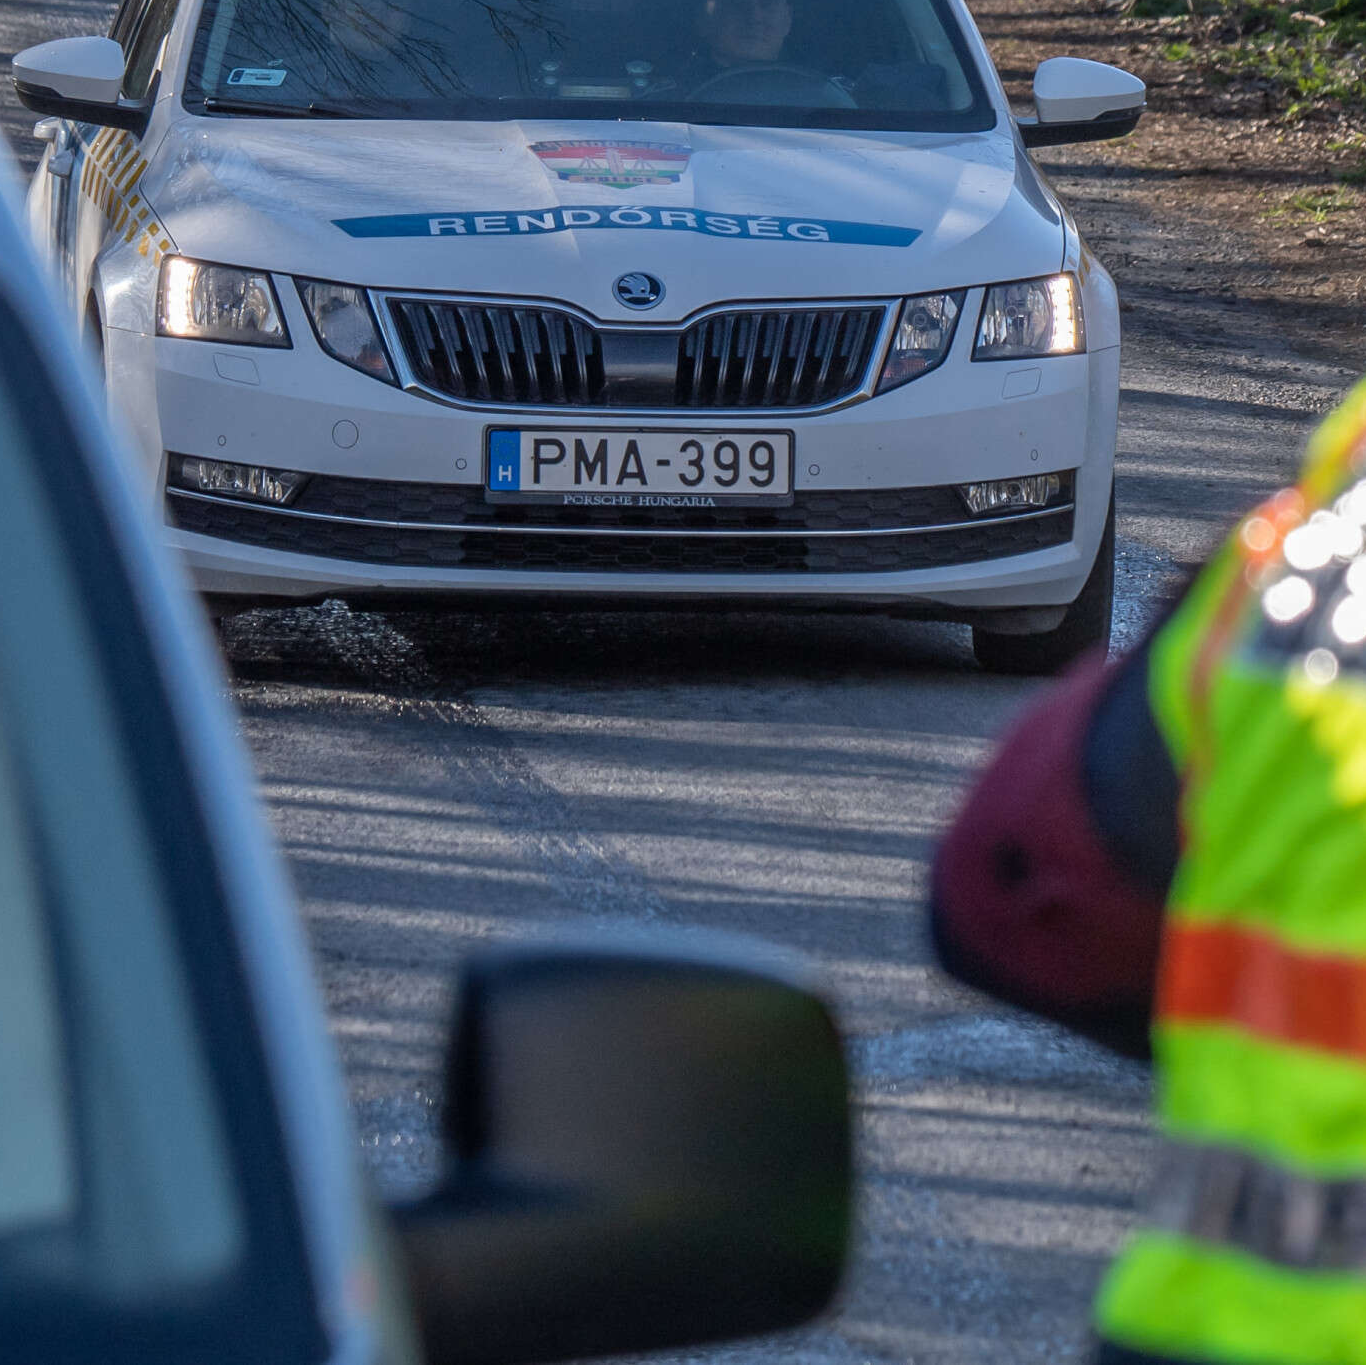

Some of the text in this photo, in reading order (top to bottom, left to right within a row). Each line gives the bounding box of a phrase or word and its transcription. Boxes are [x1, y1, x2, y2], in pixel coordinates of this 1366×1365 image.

[428, 206, 830, 242] RENDŐRSÉG
[498, 464, 512, 483] H
[532, 437, 775, 488] PMA-399
[563, 493, 716, 508] PORSCHE HUNGARIA
